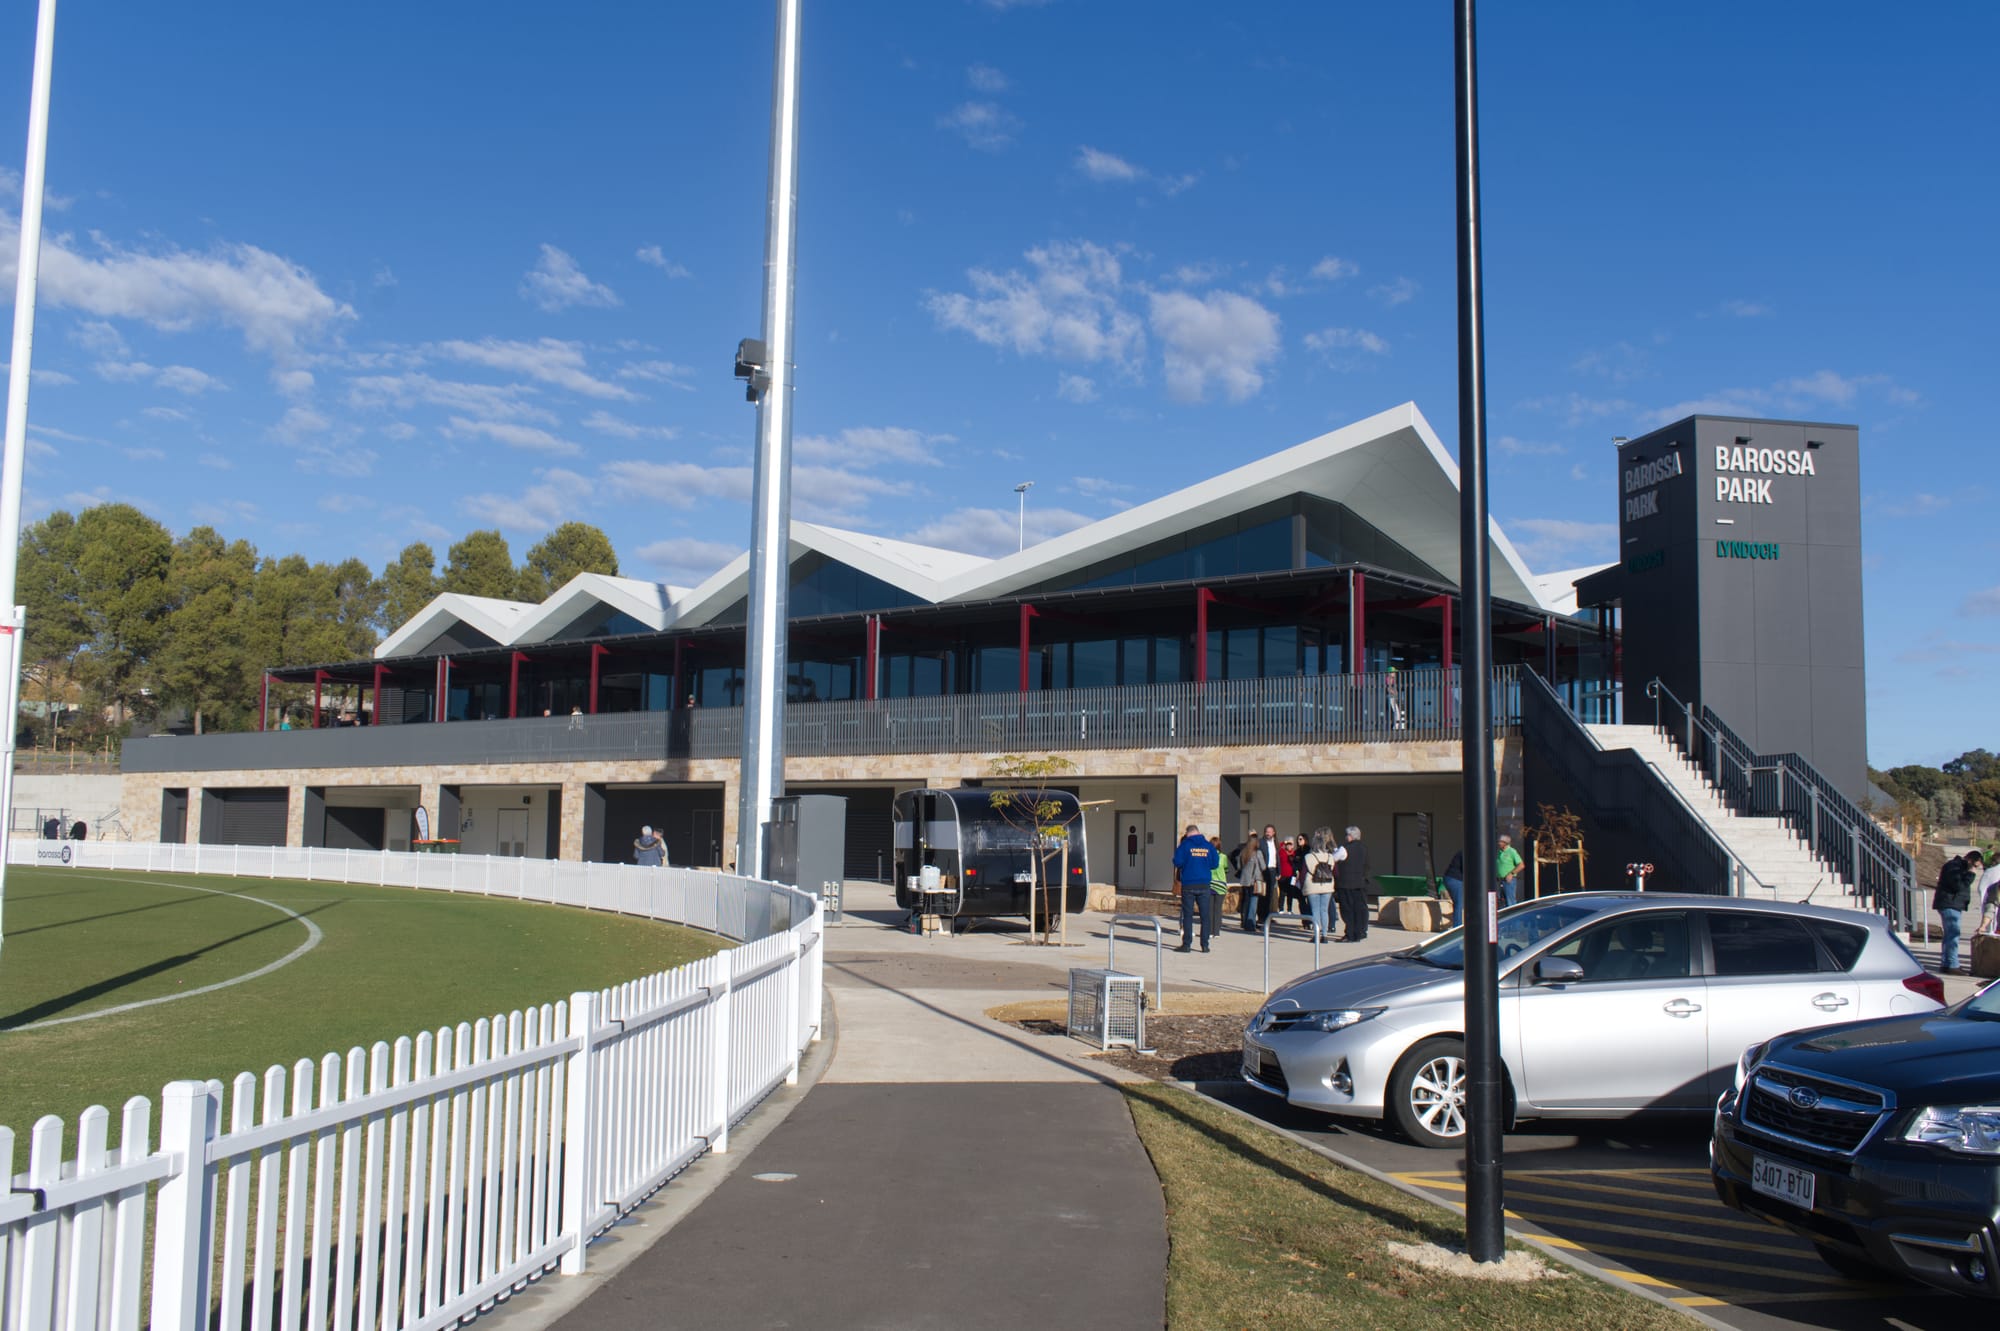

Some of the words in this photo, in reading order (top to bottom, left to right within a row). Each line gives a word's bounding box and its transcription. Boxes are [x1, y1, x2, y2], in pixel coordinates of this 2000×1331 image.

[1625, 451, 1683, 493] BAROSSA
[1715, 445, 1816, 476] BAROSSA
[1716, 476, 1773, 504] PARK
[1626, 490, 1659, 523] PARK
[1716, 540, 1780, 561] LYNDOCH
